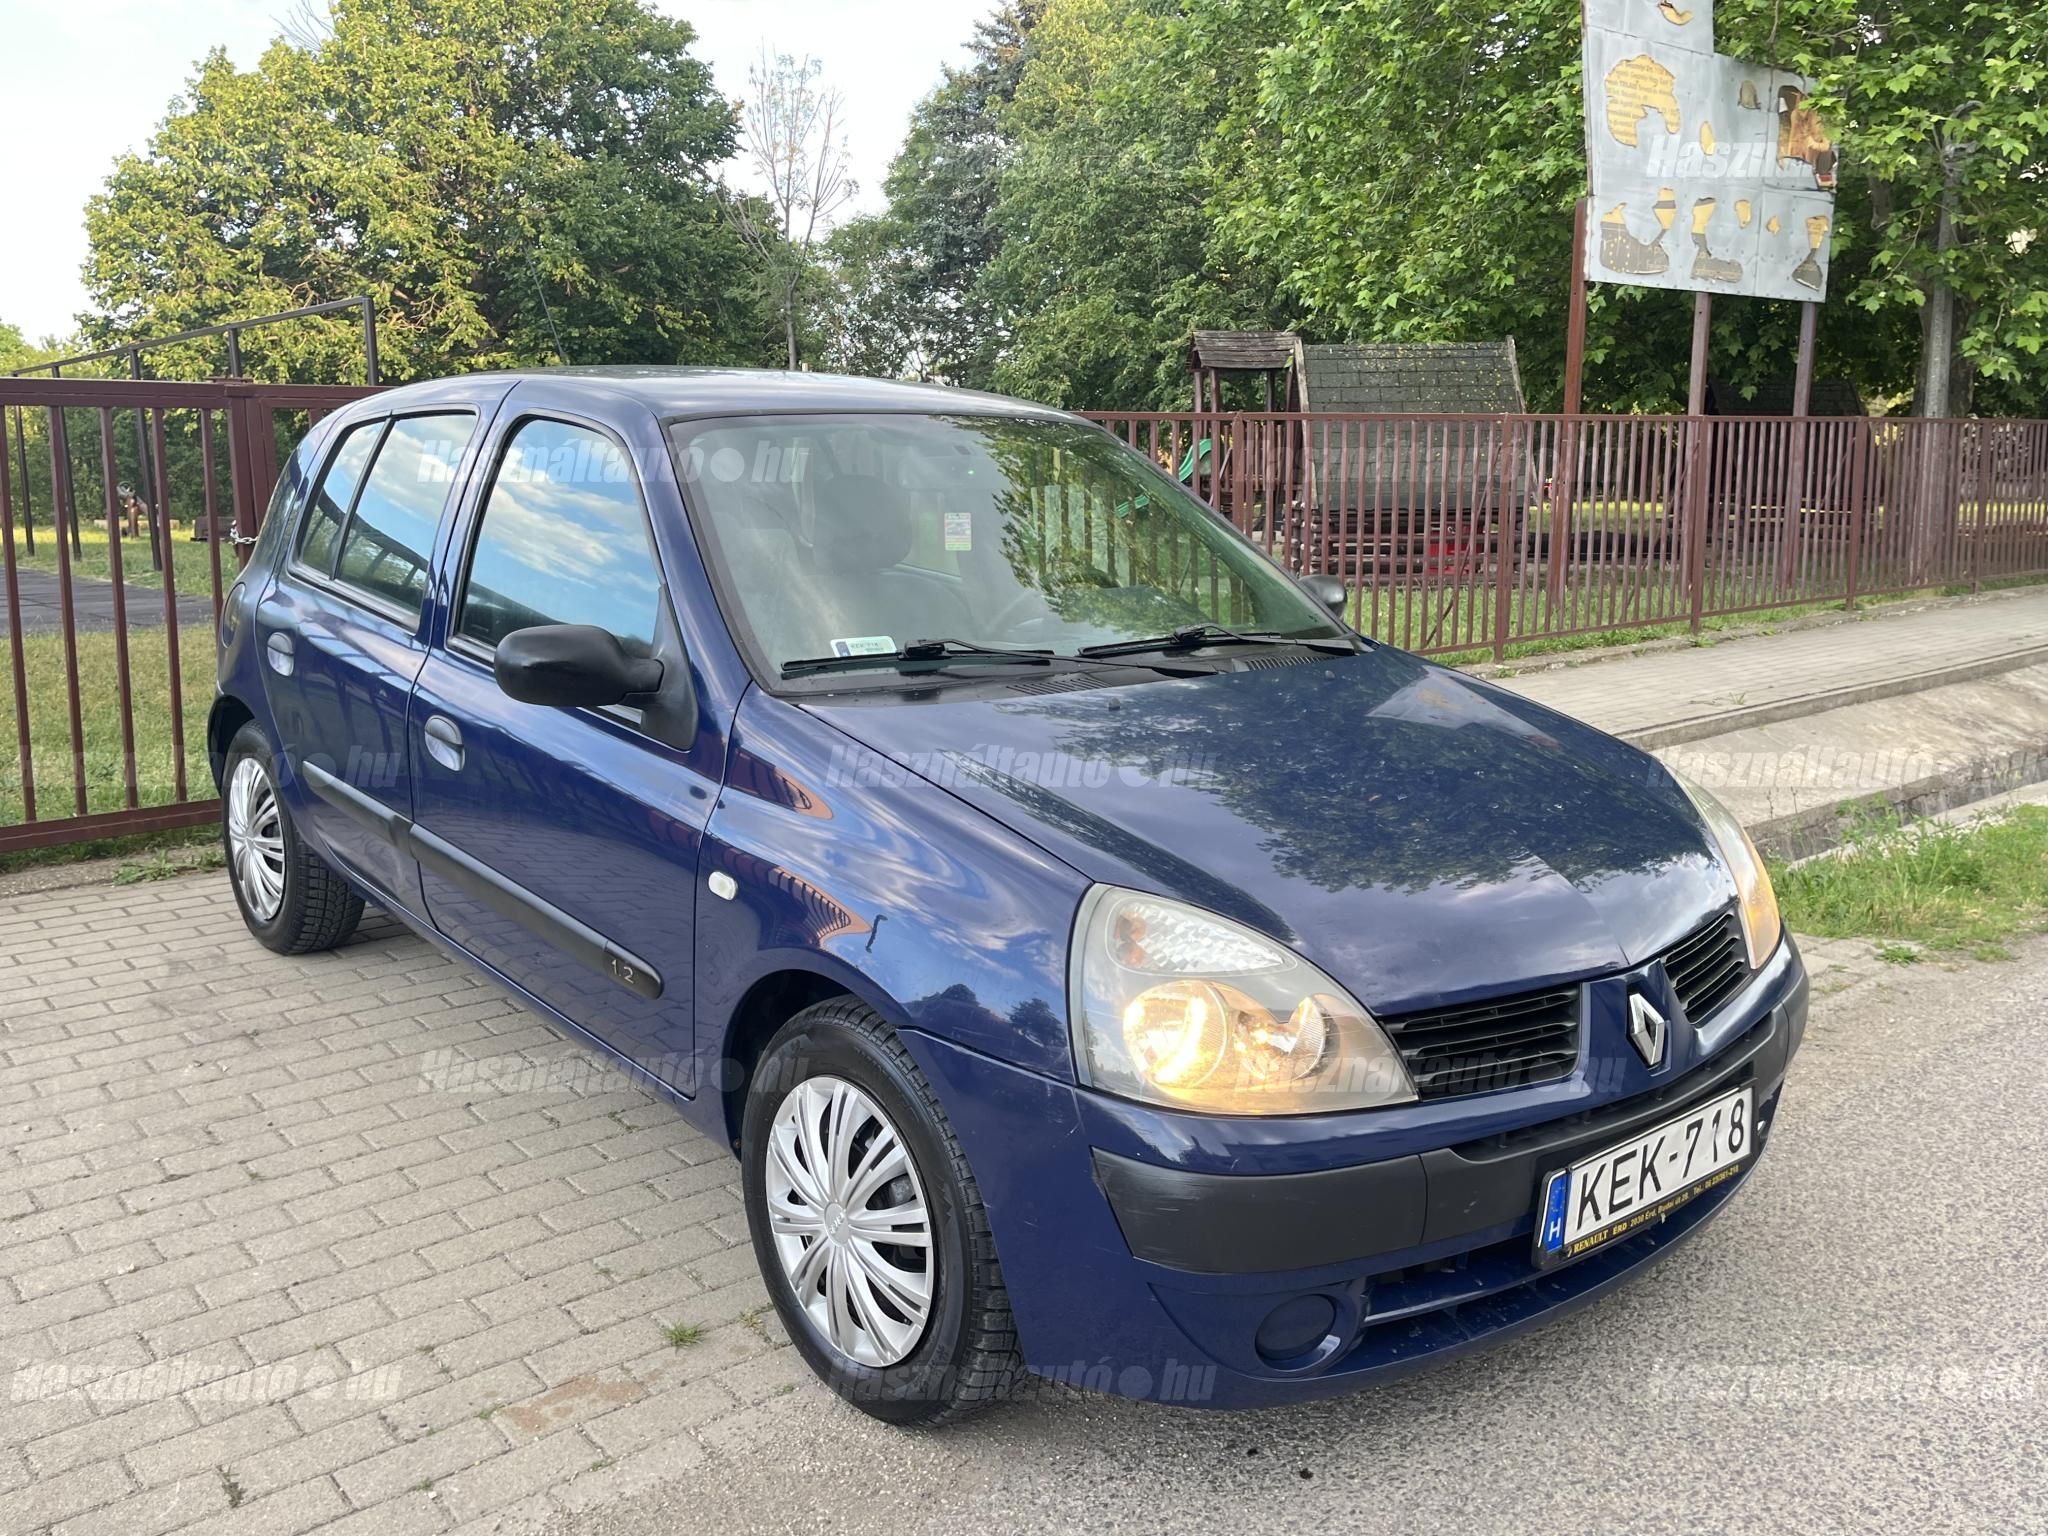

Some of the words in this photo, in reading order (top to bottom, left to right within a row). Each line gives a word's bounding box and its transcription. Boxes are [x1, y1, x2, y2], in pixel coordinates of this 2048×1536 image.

[1577, 1098, 1744, 1231] KEK-718
[1548, 1217, 1562, 1242] H
[1574, 1229, 1609, 1254] RENAULT
